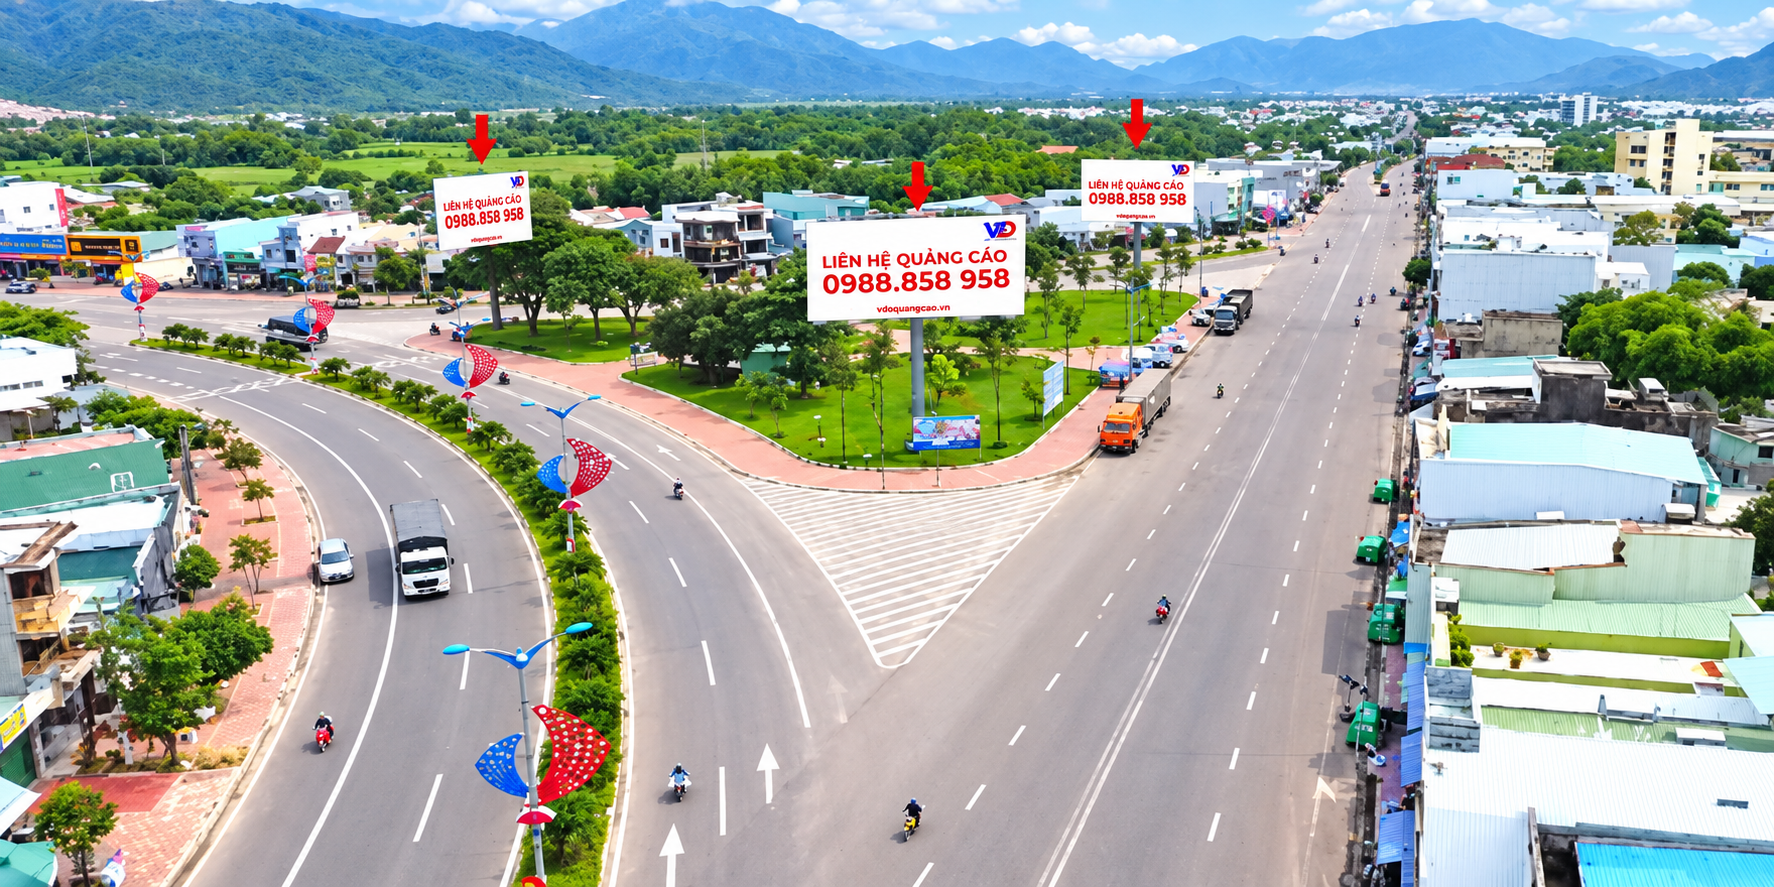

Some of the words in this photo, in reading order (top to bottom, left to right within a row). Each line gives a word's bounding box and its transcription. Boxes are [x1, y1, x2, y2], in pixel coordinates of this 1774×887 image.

[1089, 179, 1108, 190] LIÊN
[1111, 179, 1123, 191] HỆ
[1126, 178, 1160, 191] QUẢNG
[1163, 180, 1184, 190] CÁO
[443, 200, 461, 211] LIÊN
[463, 198, 474, 210] HỆ
[475, 195, 503, 209] QUẢNG
[505, 193, 522, 205] CÁO
[1089, 192, 1156, 206] 0988.858
[1159, 192, 1187, 206] 958
[445, 209, 501, 230] 0988.858
[503, 206, 525, 222] 958
[822, 251, 861, 269] LIÊN
[867, 250, 891, 271] HỆ
[897, 247, 963, 269] QUẢNG
[968, 246, 1008, 264] CÁO
[822, 269, 952, 295] 0988.858
[959, 268, 1011, 290] 958
[876, 304, 951, 315] vdoquangcao.vn
